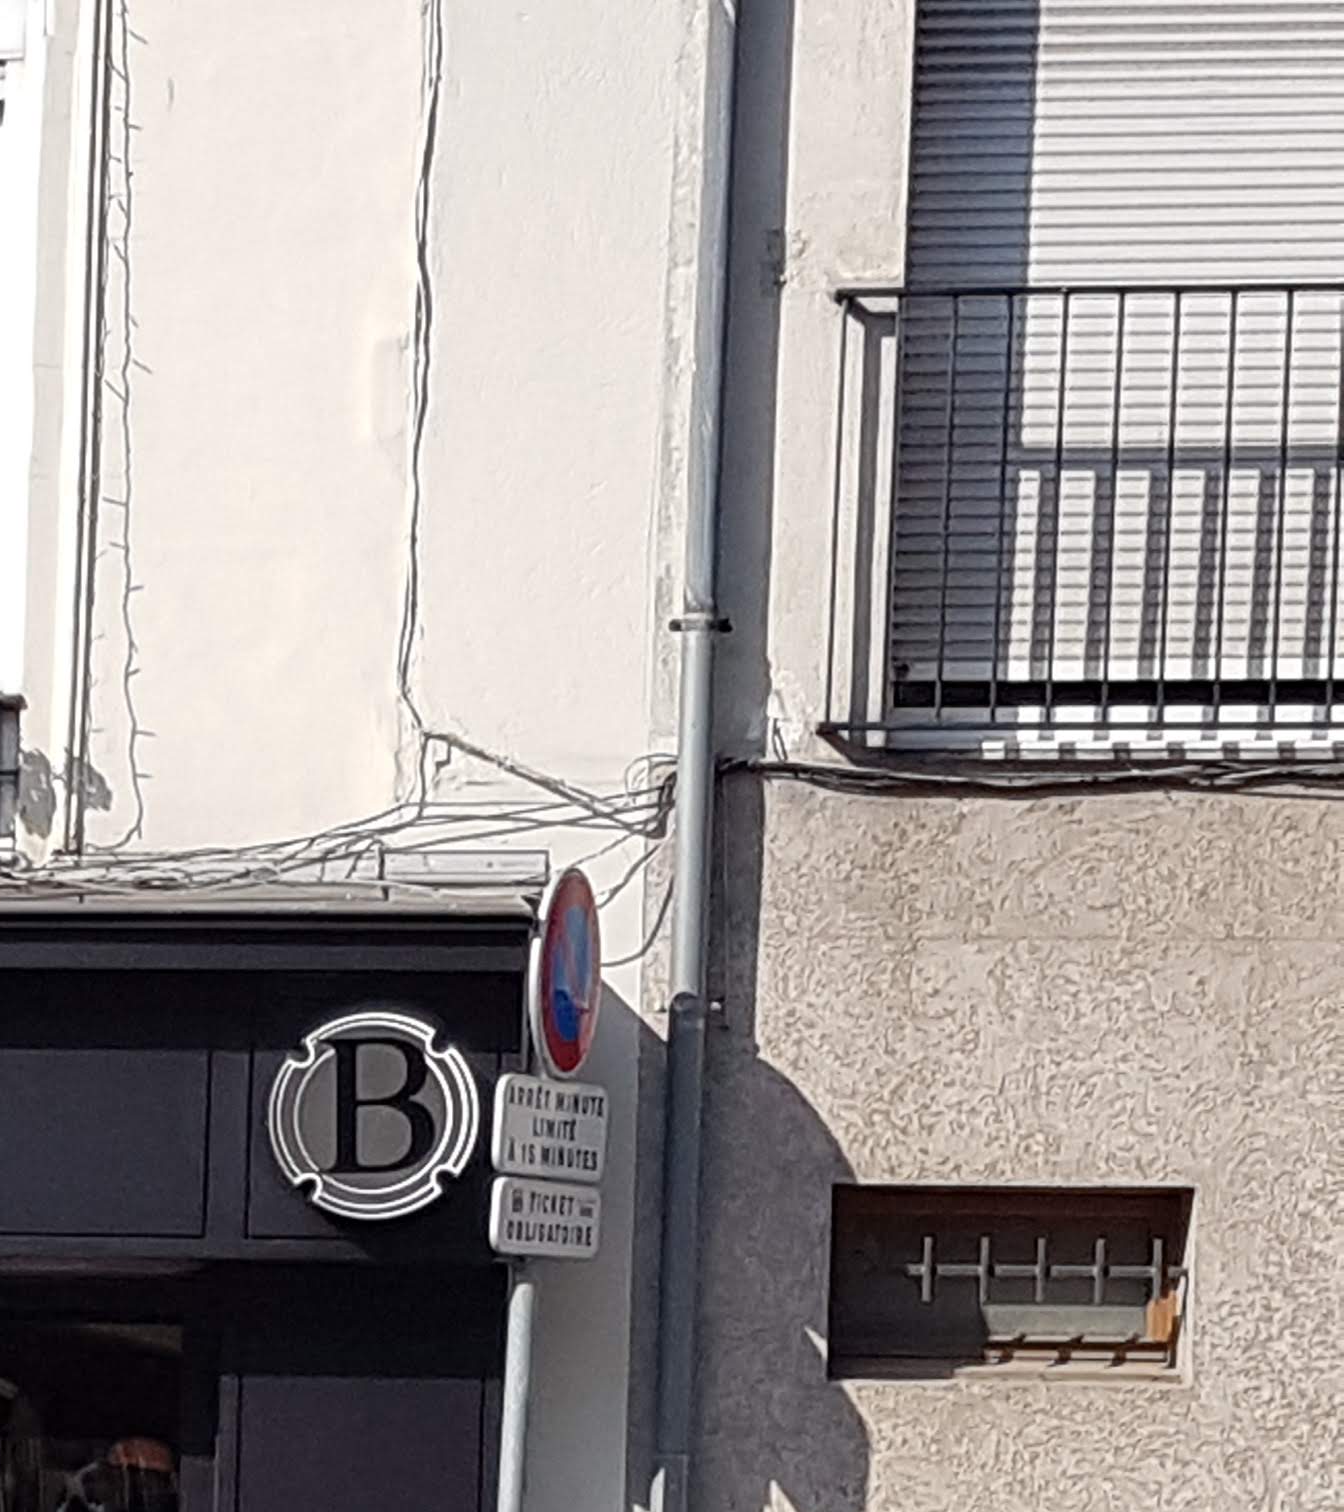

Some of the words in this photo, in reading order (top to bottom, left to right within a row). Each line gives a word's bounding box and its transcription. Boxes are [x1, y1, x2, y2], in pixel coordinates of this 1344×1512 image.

[555, 1091, 604, 1118] MINUTE
[532, 1116, 577, 1142] LIMITÉ
[521, 1143, 535, 1165] 15
[540, 1145, 598, 1171] MINUTES
[530, 1191, 575, 1217] TICKET
[506, 1219, 592, 1247] OBLIGATOIRE
